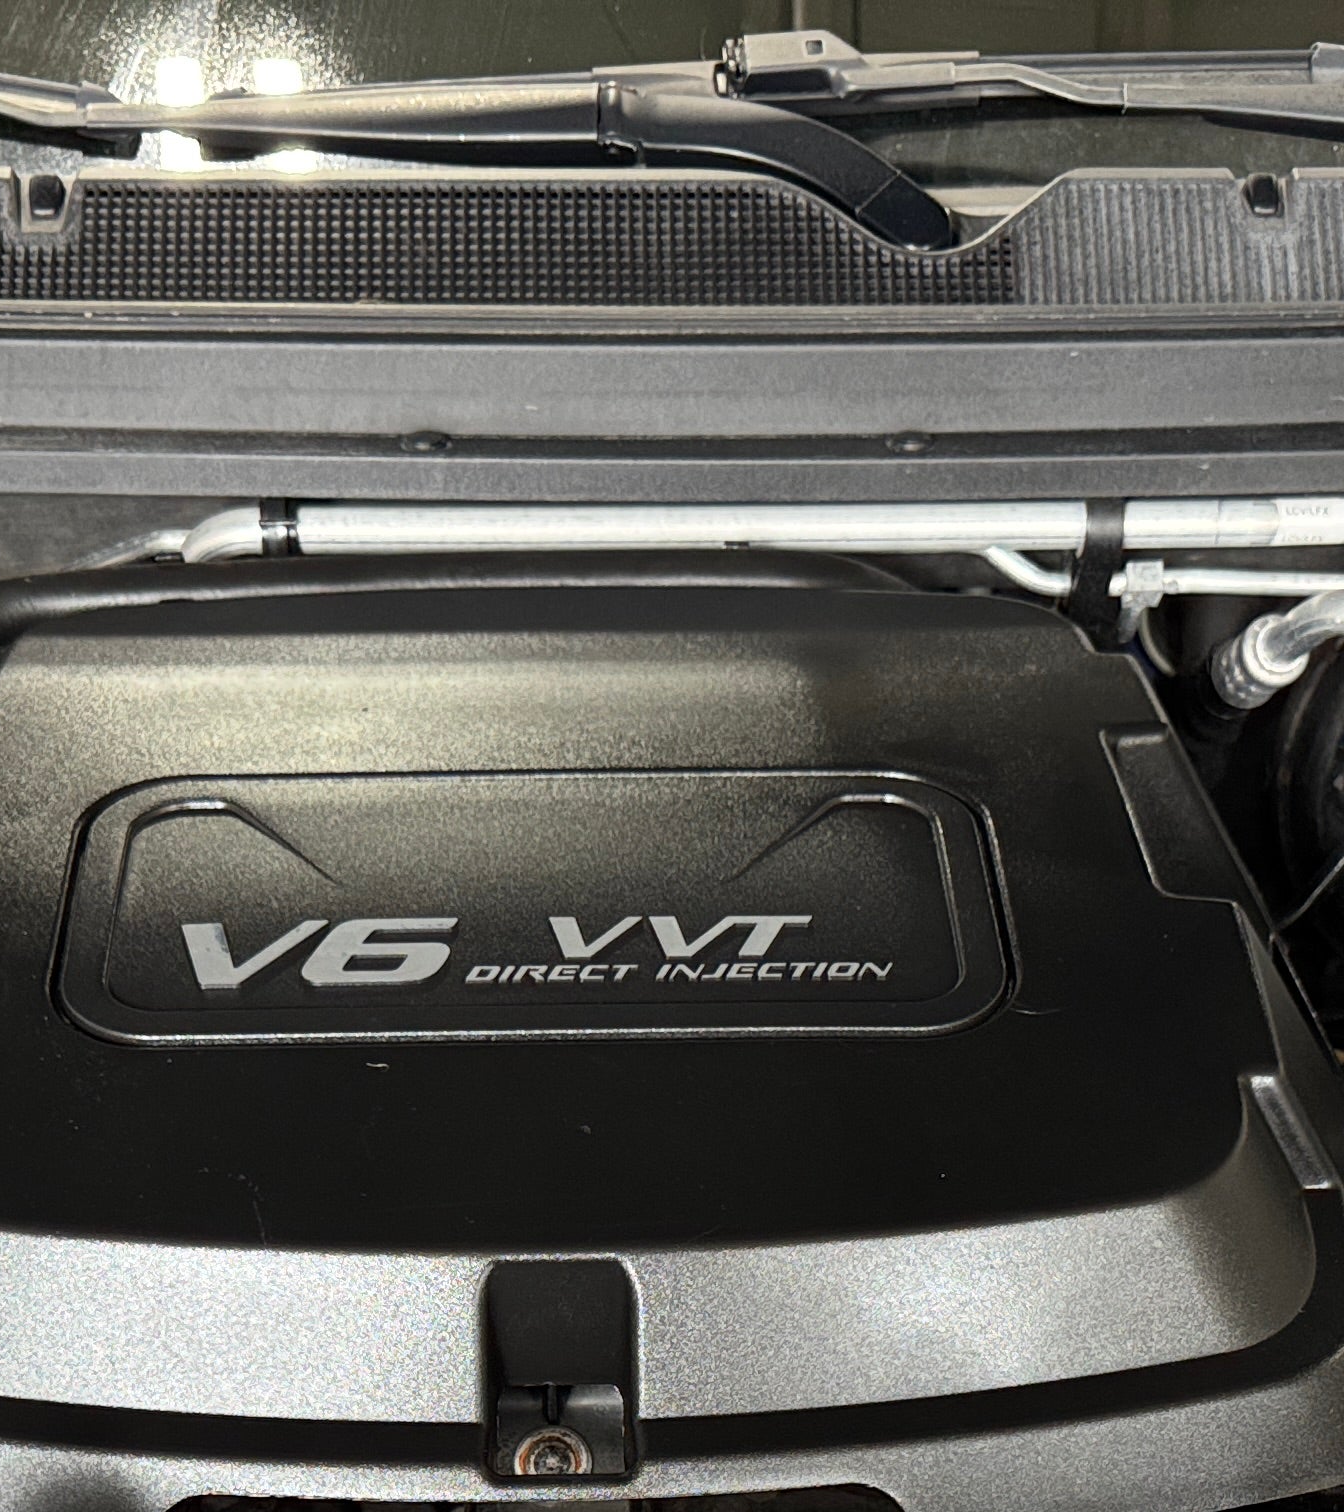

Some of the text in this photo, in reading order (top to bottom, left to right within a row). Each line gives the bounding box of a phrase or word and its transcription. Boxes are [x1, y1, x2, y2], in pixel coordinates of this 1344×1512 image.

[181, 914, 813, 989] V6 VVT
[464, 961, 894, 984] DIRECT INJECTION
